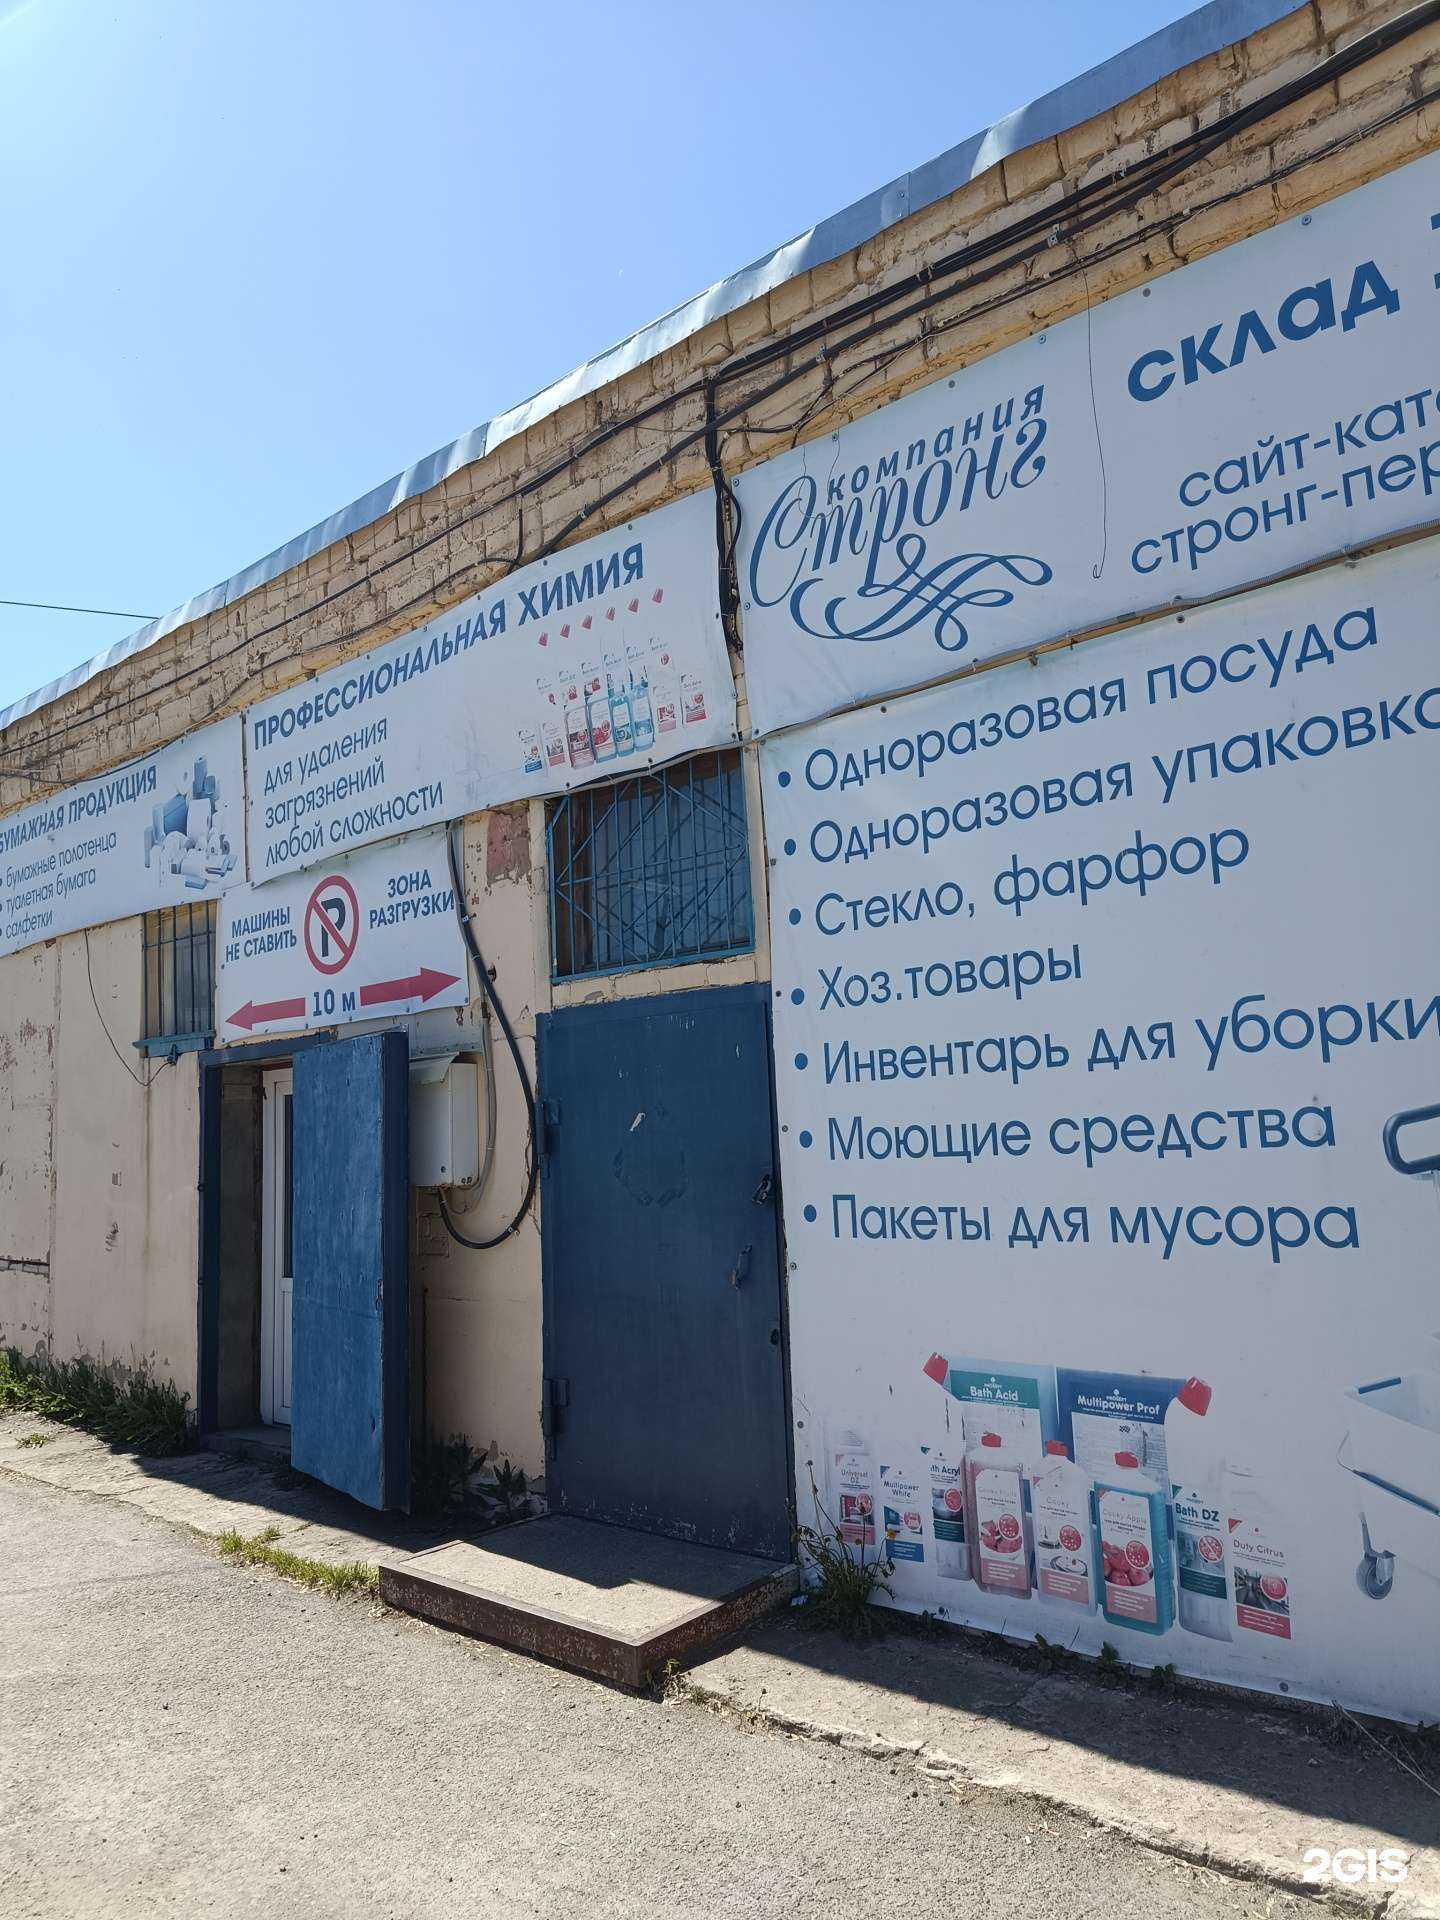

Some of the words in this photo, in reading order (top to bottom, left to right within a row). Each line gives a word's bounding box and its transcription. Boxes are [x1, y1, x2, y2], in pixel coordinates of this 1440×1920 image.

[1126, 260, 1400, 402] склад
[826, 385, 1045, 507] компания
[1178, 388, 1440, 507] сайт-кат
[749, 417, 1048, 612] Стронг
[253, 599, 507, 750] ПРОФЕССИОНАЛЬНАЯ
[517, 542, 645, 626] ХИМИЯ
[804, 679, 1127, 792] Одноразовая
[1146, 606, 1380, 704] посуда
[263, 758, 292, 796] для
[298, 717, 388, 787] удаления
[68, 765, 157, 824] ПРОДУКЦИЯ
[264, 760, 386, 829] загрязнений
[265, 823, 324, 867] любой
[329, 781, 444, 840] сложности
[809, 761, 1135, 864] Одноразовая
[6, 855, 56, 890] бумажные
[58, 832, 117, 866] полотенца
[387, 868, 432, 898] ЗОНА
[815, 881, 975, 936] Стекло,
[992, 827, 1250, 916] фарфор
[6, 882, 54, 916] туалетная
[56, 868, 96, 900] бумага
[231, 906, 291, 939] МАШИНЫ
[369, 889, 455, 930] РАЗГРУЗКИ
[6, 910, 53, 939] салфетки
[225, 942, 240, 963] НЕ
[243, 929, 298, 958] СТАВИТЬ
[313, 989, 335, 1016] 10
[817, 943, 1083, 1011] Хоз.товары
[822, 1032, 1070, 1086] Инвентарь
[1086, 1021, 1176, 1073] для
[1195, 994, 1440, 1072] уборки
[827, 1114, 1032, 1165] Моющие
[1048, 1105, 1336, 1168] средства
[832, 1193, 993, 1242] Пакеты
[1007, 1205, 1091, 1250] для
[1109, 1203, 1361, 1264] мусора
[970, 1386, 993, 1399] Bath
[995, 1389, 1018, 1402] Acid
[1077, 1394, 1135, 1413] Multipower
[1137, 1403, 1160, 1415] Prof
[883, 1480, 920, 1492] Multipower
[941, 1465, 961, 1476] Acryl
[1175, 1502, 1199, 1519] Bath
[1202, 1508, 1220, 1522] DZ
[1233, 1539, 1254, 1553] Duty
[1256, 1544, 1285, 1558] Citrus
